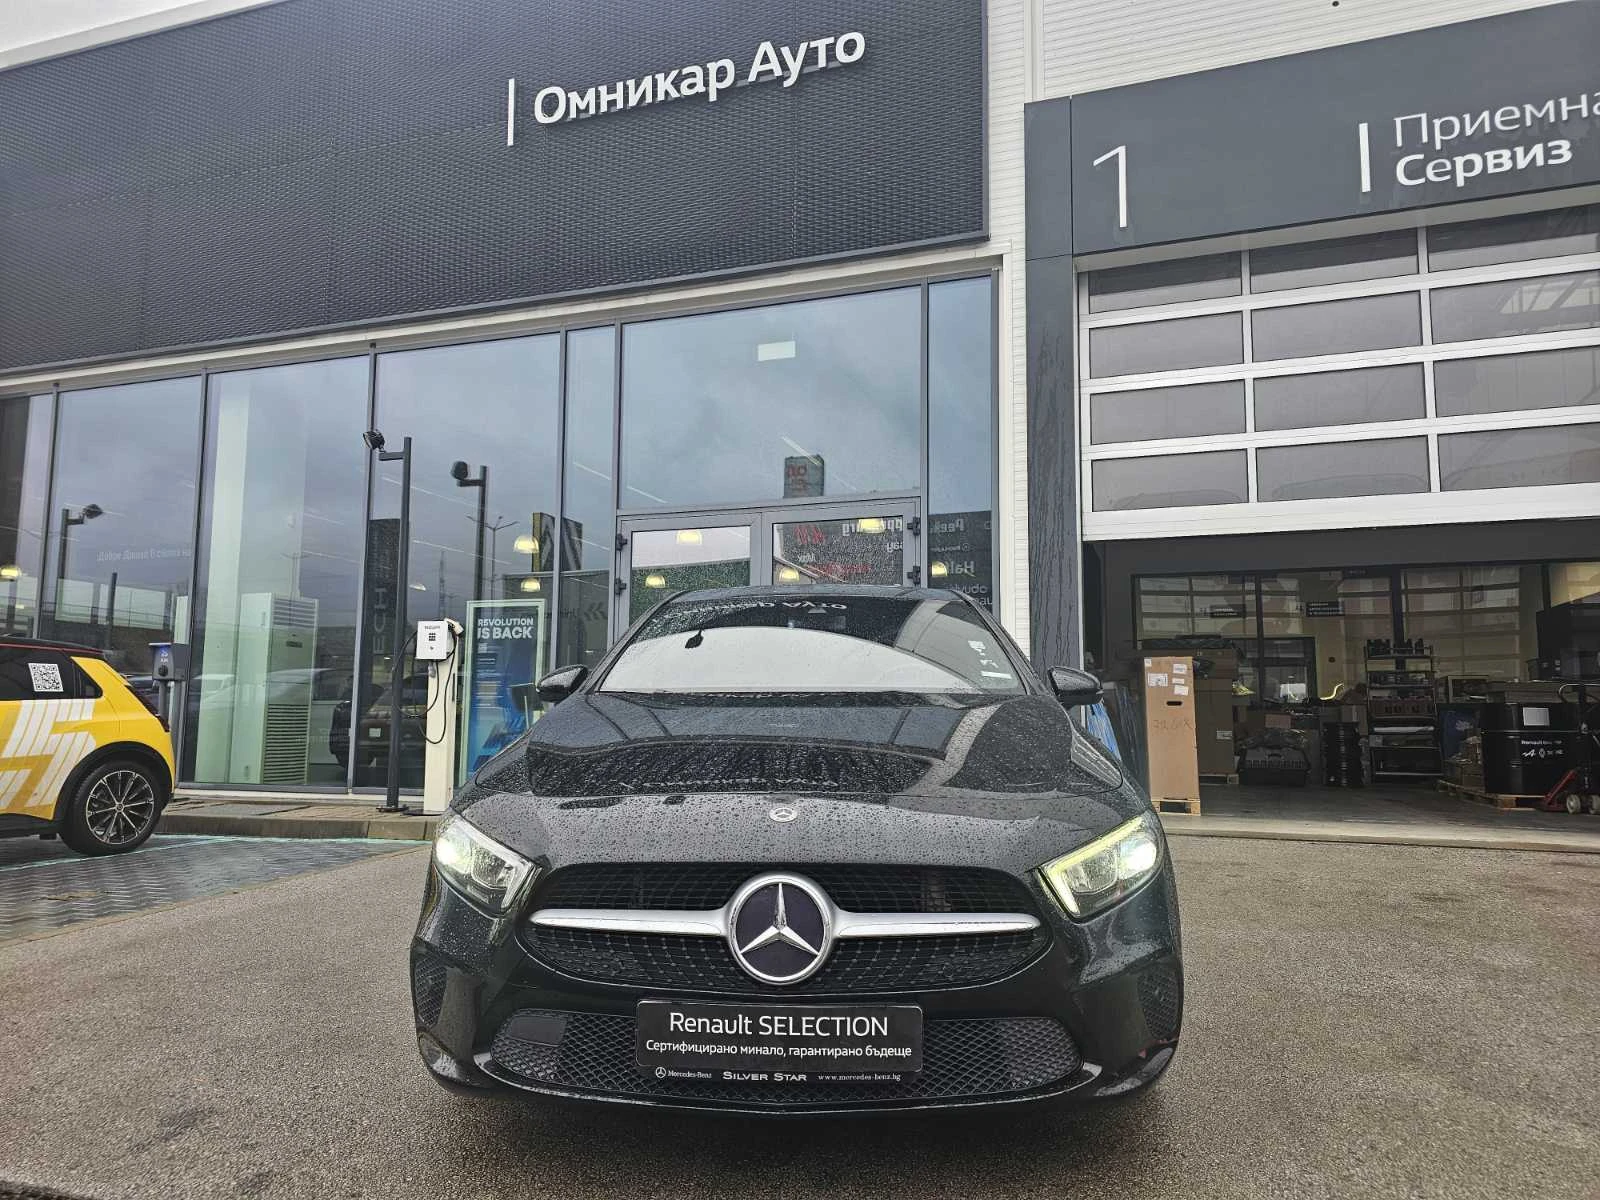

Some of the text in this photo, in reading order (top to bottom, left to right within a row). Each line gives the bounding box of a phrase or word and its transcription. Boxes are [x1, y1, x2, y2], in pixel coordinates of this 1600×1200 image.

[533, 31, 866, 125] Омникар Ауто
[1396, 138, 1574, 188] Сервиз
[1092, 145, 1128, 228] 1
[477, 626, 533, 640] IS BACK
[669, 1012, 888, 1037] Renault SELECTION
[646, 1039, 912, 1059] Сертифицирано минало, гарантирано бъдеще
[818, 1073, 901, 1082] www.mercedes-benz.bg
